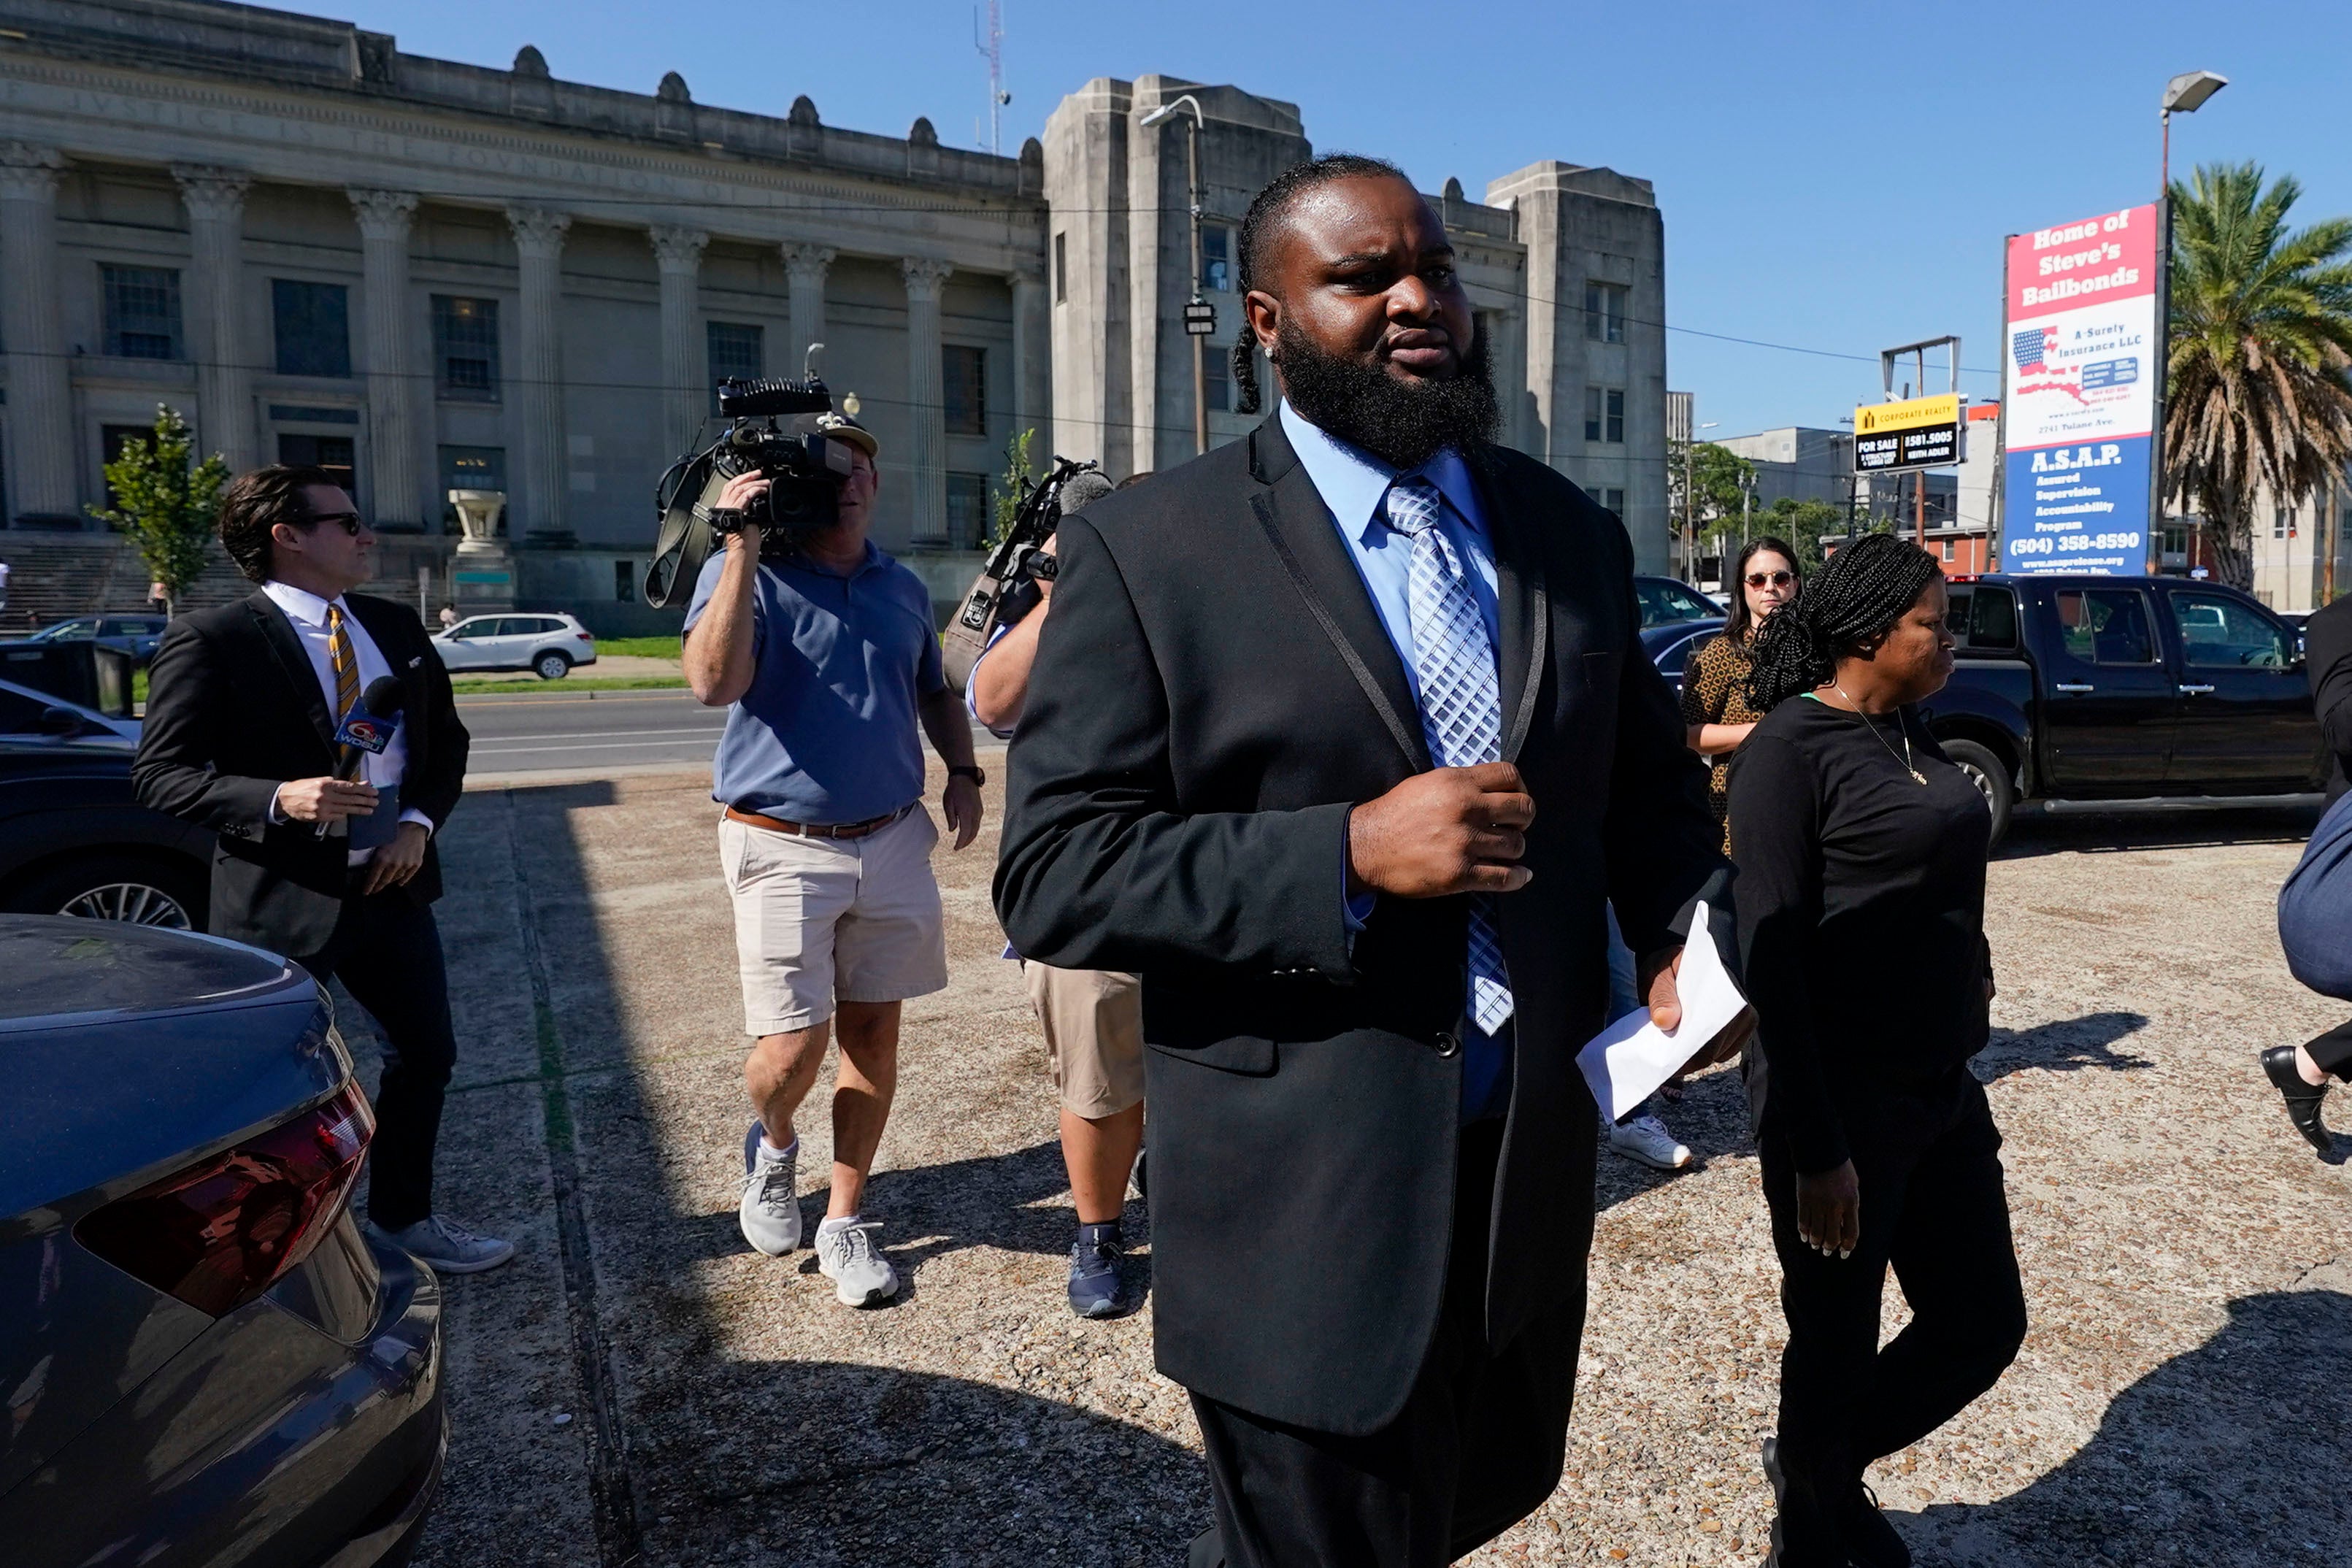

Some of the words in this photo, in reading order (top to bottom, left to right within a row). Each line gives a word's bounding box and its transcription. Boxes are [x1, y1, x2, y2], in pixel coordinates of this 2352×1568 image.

[348, 129, 415, 157] THE
[2033, 221, 2099, 250] Home
[2103, 209, 2130, 233] of
[2039, 242, 2121, 276] Steve's
[2021, 266, 2140, 307] Bailbonds
[2059, 341, 2115, 358] Insurance
[2119, 335, 2142, 347] LLC
[1880, 410, 1922, 423] CORPORATE
[1925, 405, 1951, 416] REALTY
[2039, 425, 2059, 434] 2741
[2062, 420, 2093, 431] Tulane
[1858, 441, 1876, 453] FOR
[1876, 438, 1898, 450] SALE
[1907, 449, 1927, 459] KEITH
[1928, 446, 1950, 457] ADLER
[2031, 444, 2122, 473] A.S.A.P.
[2036, 472, 2080, 487] Assured
[2035, 486, 2102, 501] Supervision
[2035, 501, 2115, 517] Accountability
[2034, 520, 2083, 533] Program
[2010, 537, 2053, 556] (504)
[2057, 532, 2140, 552] 358-8590
[340, 734, 380, 752] WDSU
